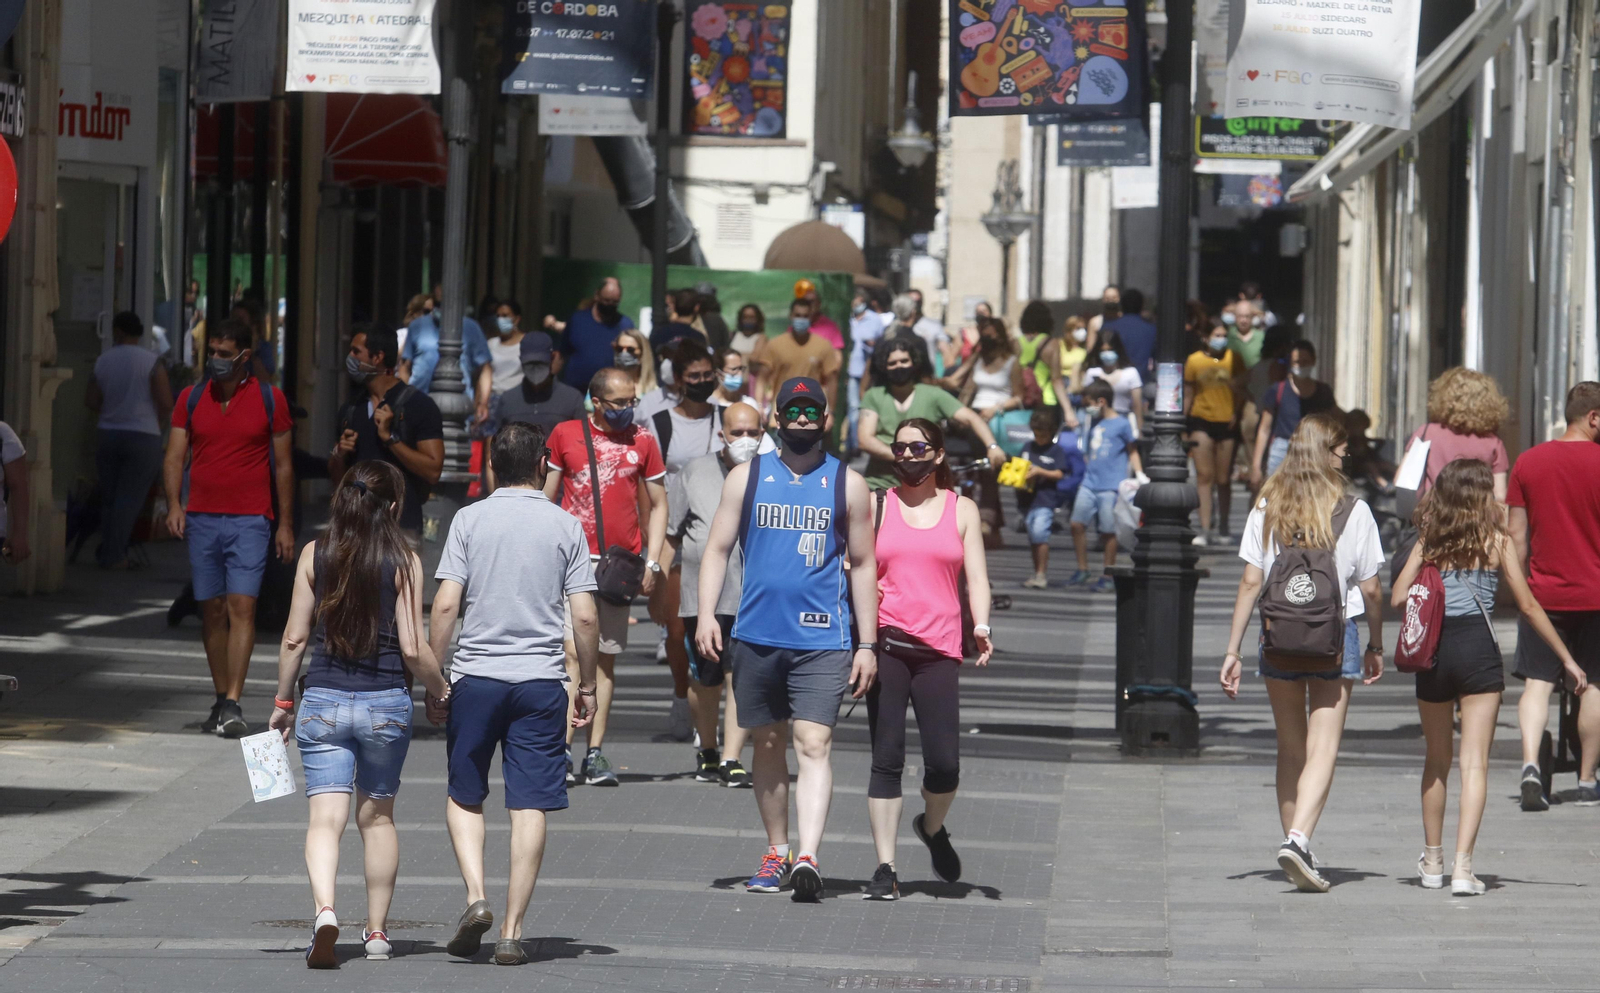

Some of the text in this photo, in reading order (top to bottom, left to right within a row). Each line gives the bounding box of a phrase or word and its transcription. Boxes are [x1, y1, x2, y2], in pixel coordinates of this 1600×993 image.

[1306, 1, 1341, 10] MAIKEL
[1343, 3, 1356, 11] DE
[1371, 5, 1393, 15] RIVA
[1320, 14, 1367, 25] SIDECARS
[1312, 27, 1334, 36] SUZI
[1336, 28, 1373, 38] QUATRO
[756, 502, 832, 531] DALLAS
[796, 532, 827, 568] 41
